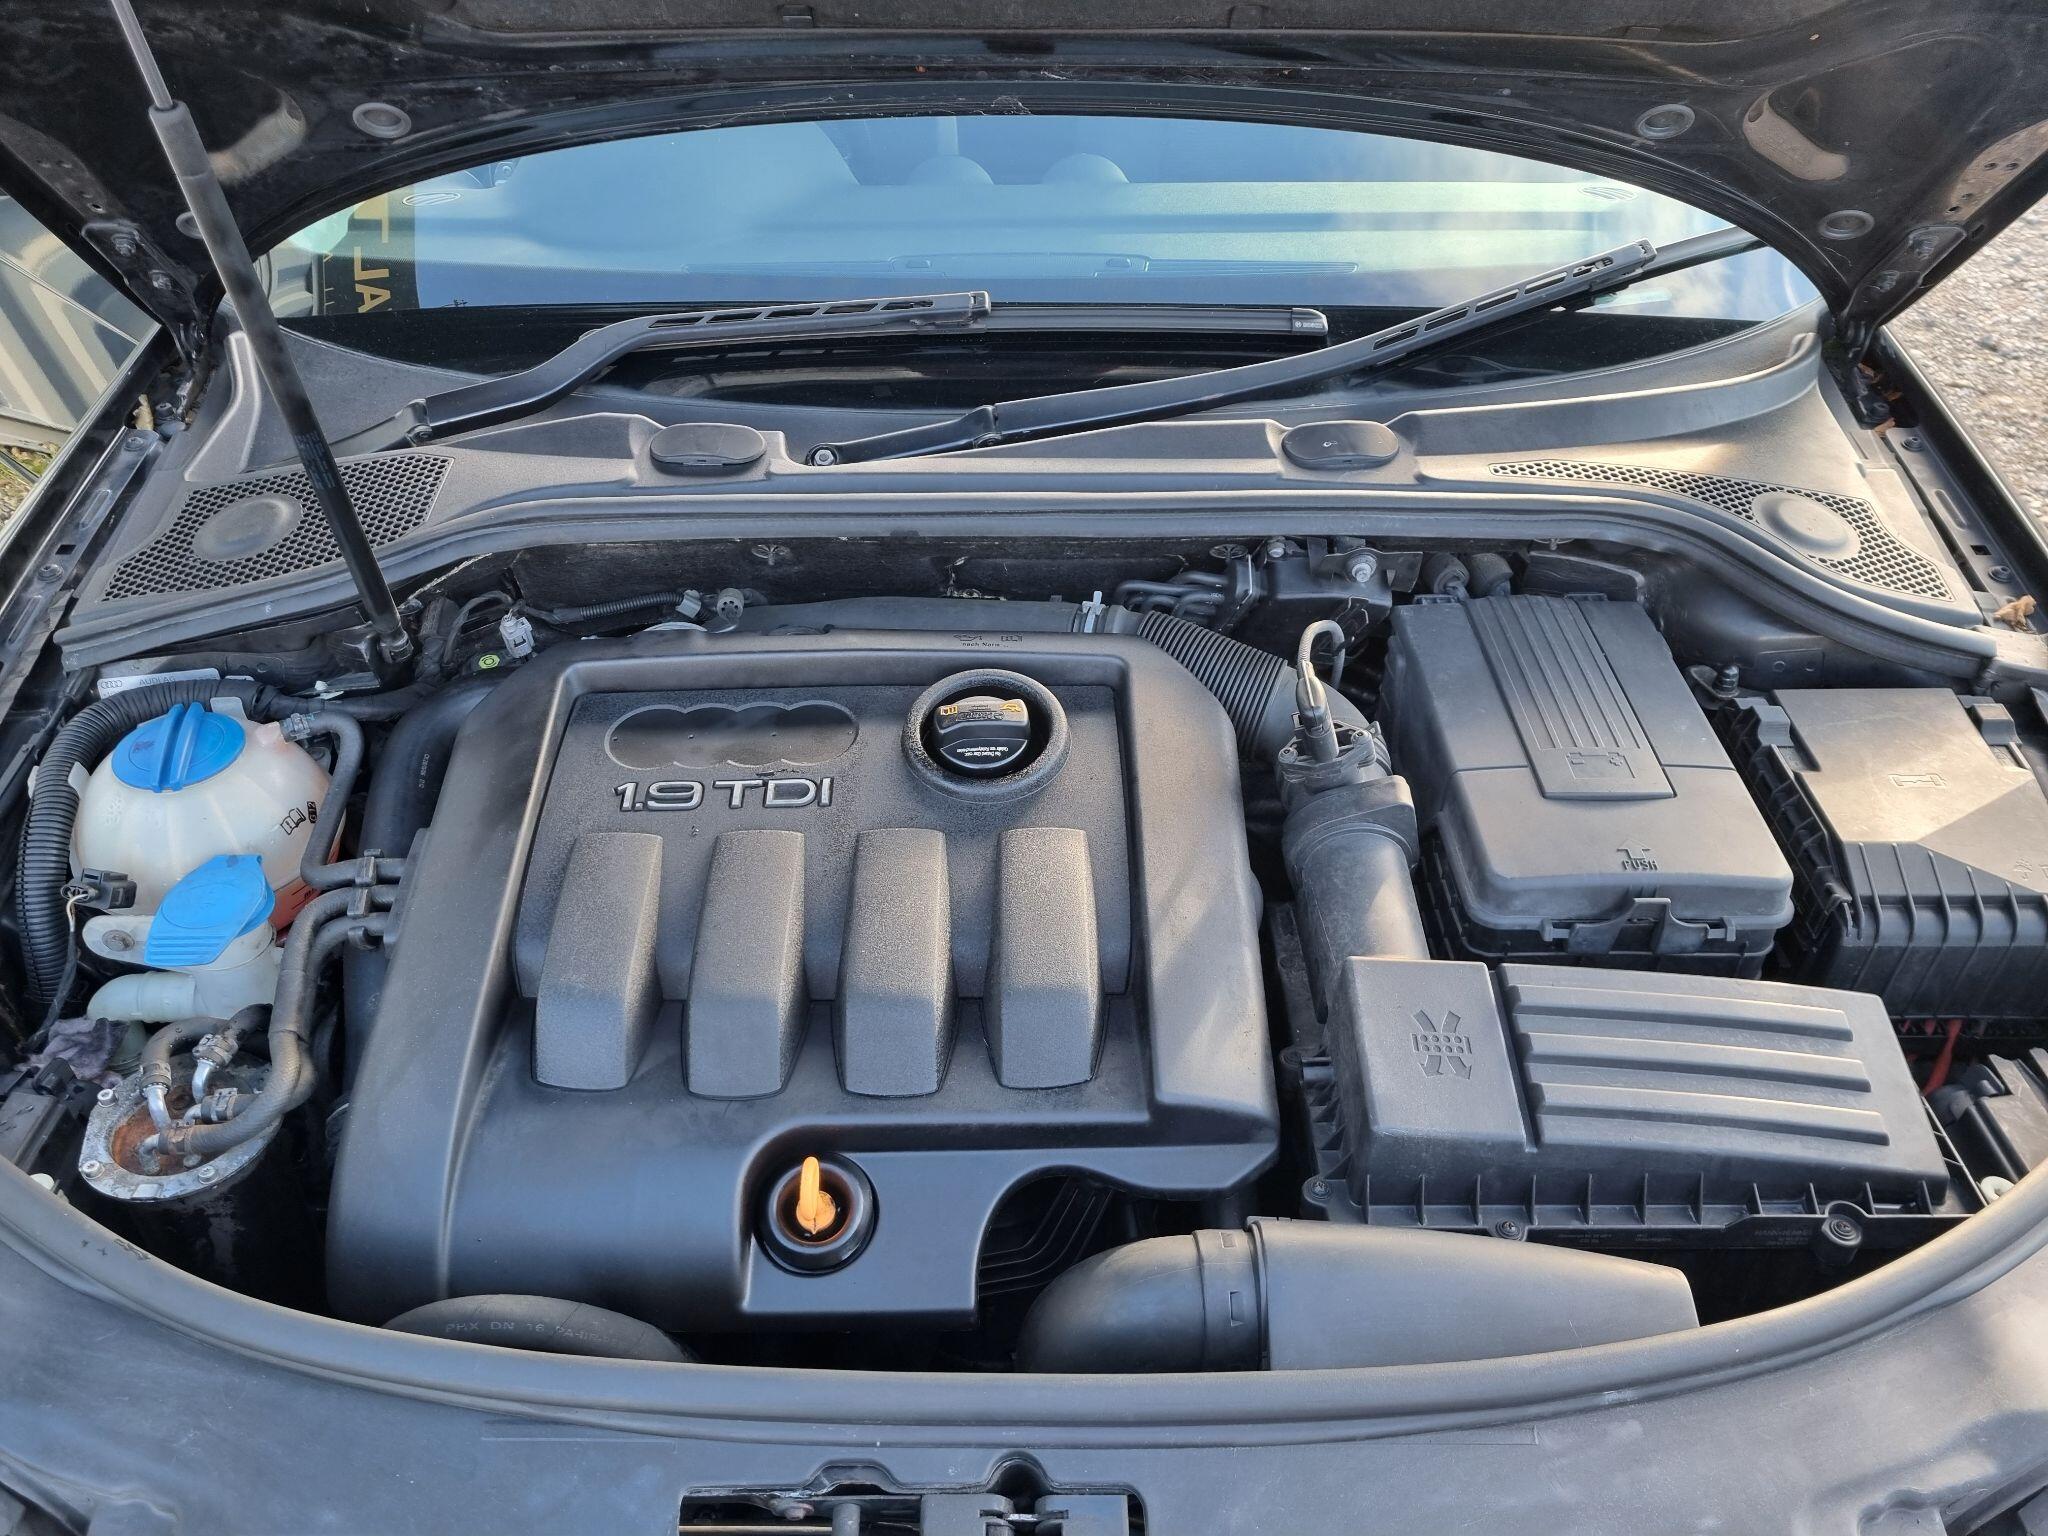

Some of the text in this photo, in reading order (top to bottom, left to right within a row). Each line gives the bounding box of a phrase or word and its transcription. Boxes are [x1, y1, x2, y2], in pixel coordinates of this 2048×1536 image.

[613, 777, 835, 812] 1.9 TDI
[1622, 859, 1660, 871] PUSH
[490, 1321, 515, 1331] DN
